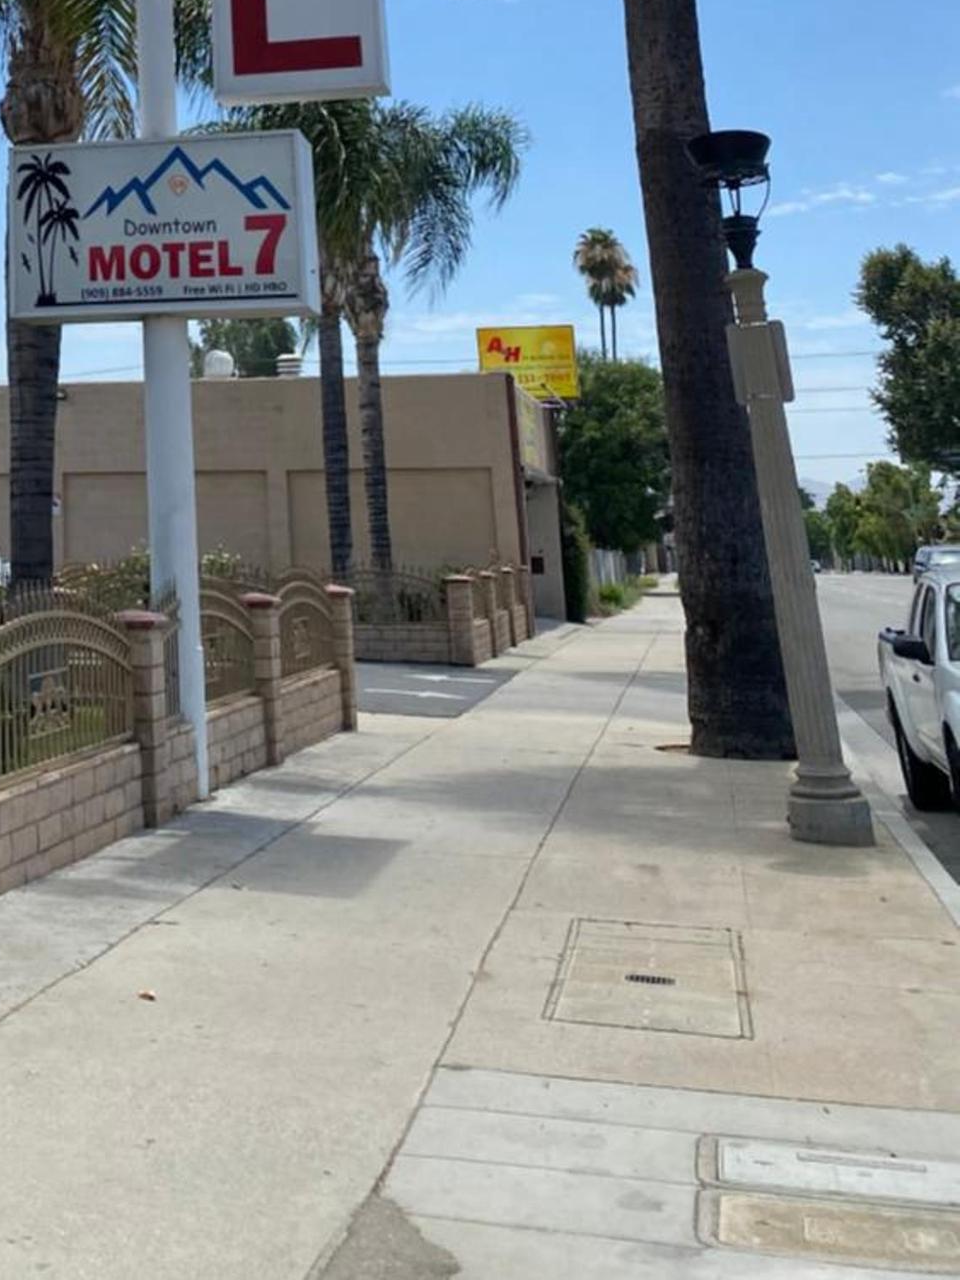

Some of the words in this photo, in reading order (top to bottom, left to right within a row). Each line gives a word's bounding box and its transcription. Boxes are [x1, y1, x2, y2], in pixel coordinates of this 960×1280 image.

[124, 218, 218, 237] Downtown
[89, 241, 244, 281] MOTEL
[244, 213, 287, 275] 7
[183, 284, 206, 295] Free
[262, 280, 288, 292] HBO
